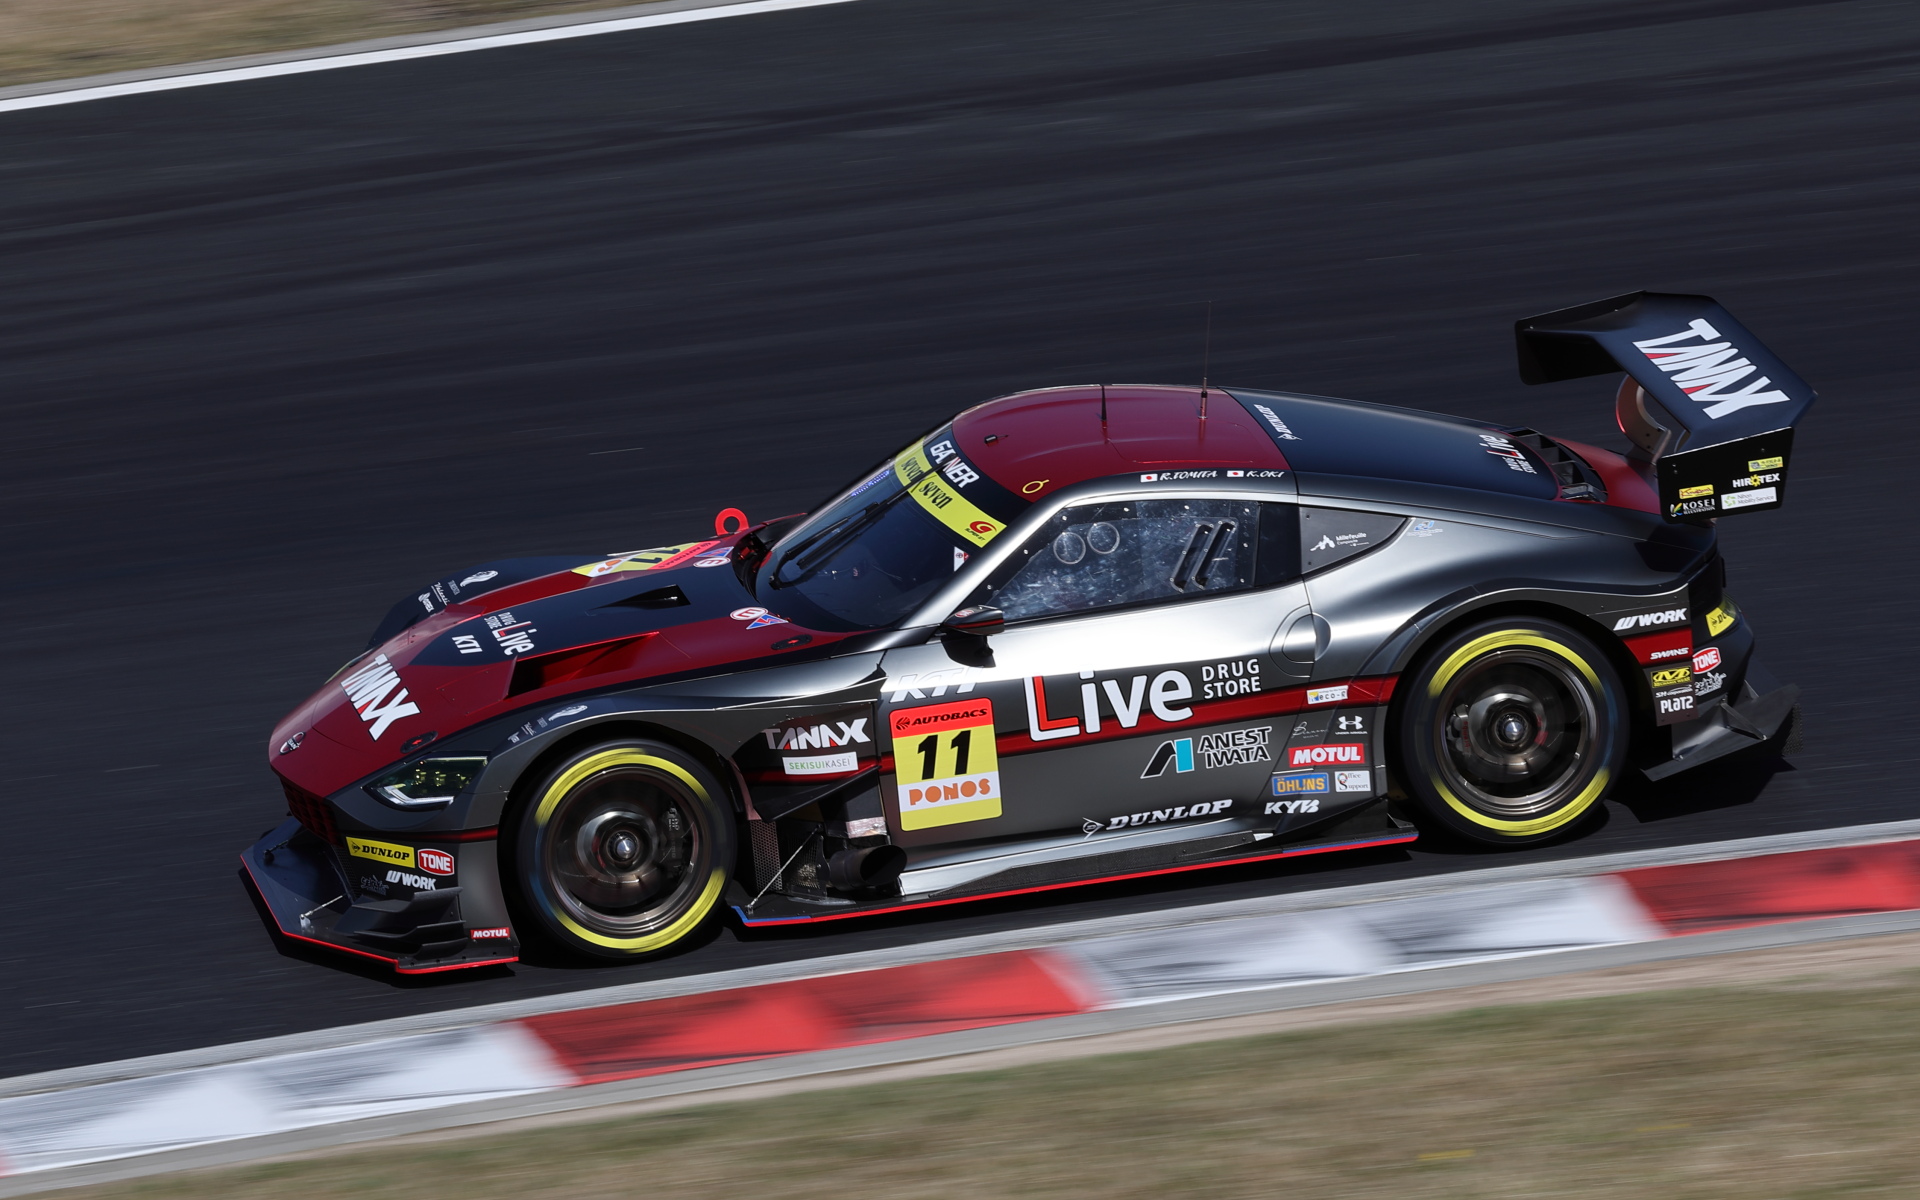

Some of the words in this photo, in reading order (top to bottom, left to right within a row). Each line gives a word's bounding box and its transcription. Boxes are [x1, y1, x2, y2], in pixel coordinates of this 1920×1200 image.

[918, 481, 953, 509] seven
[1682, 498, 1716, 510] KOSEI
[451, 634, 483, 654] KTI
[491, 620, 538, 656] Live
[1650, 647, 1689, 660] SWANS
[1692, 650, 1718, 671] TONE
[1202, 658, 1260, 682] DRUG
[1203, 676, 1262, 700] STORE
[911, 708, 988, 726] AUTOBACS
[1024, 670, 1194, 742] Live
[761, 717, 872, 750] TANAX
[1197, 726, 1272, 753] ANEST
[917, 730, 972, 780] 11
[1206, 744, 1271, 769] IWATA
[1292, 746, 1361, 765] MOTUL
[908, 778, 991, 806] PONOS
[1106, 799, 1233, 830] DUNLOP
[1264, 799, 1320, 815] KYB
[362, 844, 410, 861] DUNLOP
[421, 852, 451, 872] TONE
[472, 930, 508, 938] MOTUL
